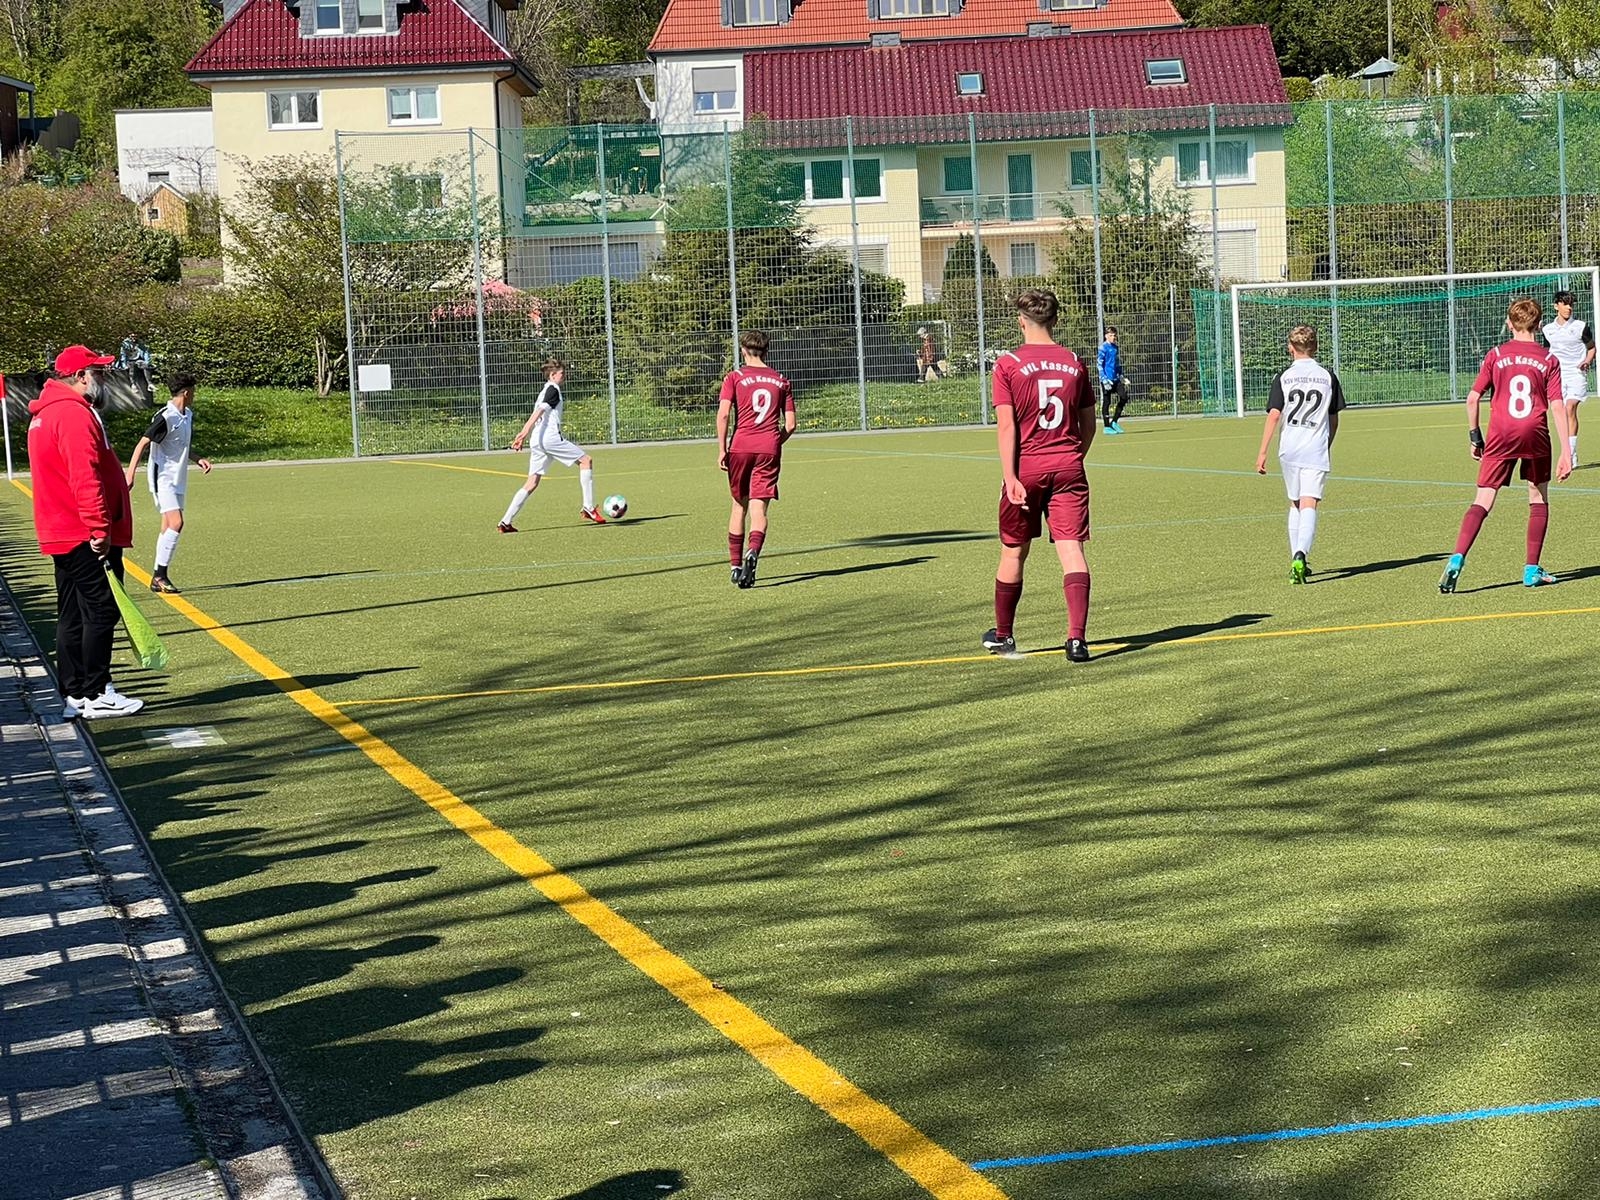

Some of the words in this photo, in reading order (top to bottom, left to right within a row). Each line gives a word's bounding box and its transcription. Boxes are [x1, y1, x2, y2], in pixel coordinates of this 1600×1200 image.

[741, 377, 755, 387] VfL
[755, 375, 784, 388] Kassel
[1020, 362, 1039, 376] VfL
[1040, 360, 1079, 377] Kassel
[1497, 357, 1513, 369] VfL
[1515, 355, 1547, 373] Kassel
[752, 388, 772, 425] 9
[1037, 379, 1064, 430] 5
[1287, 389, 1323, 428] 22
[1508, 374, 1532, 419] 8
